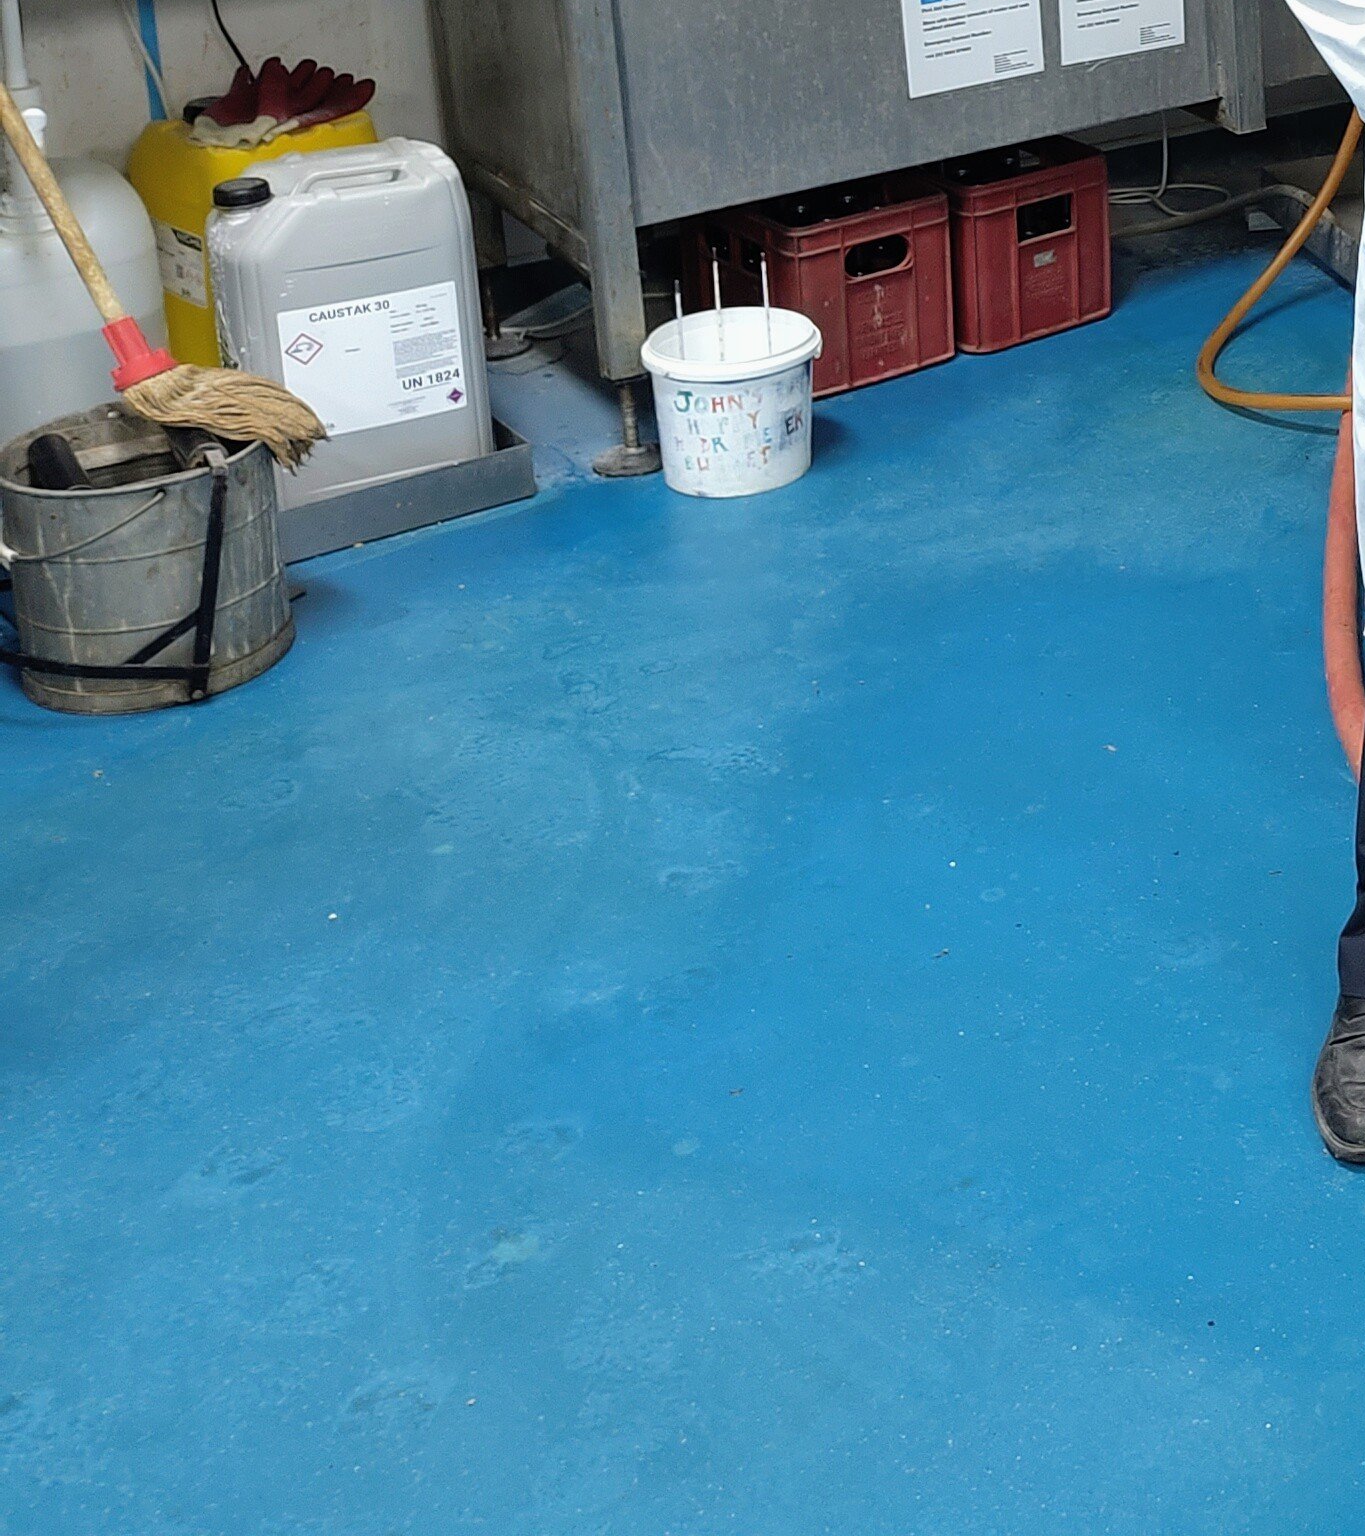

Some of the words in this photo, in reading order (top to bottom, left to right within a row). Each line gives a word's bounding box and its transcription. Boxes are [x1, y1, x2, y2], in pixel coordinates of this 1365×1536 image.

[309, 303, 371, 323] CAUSTAK
[375, 300, 390, 311] 30
[402, 377, 423, 390] UN
[427, 368, 460, 385] 1824
